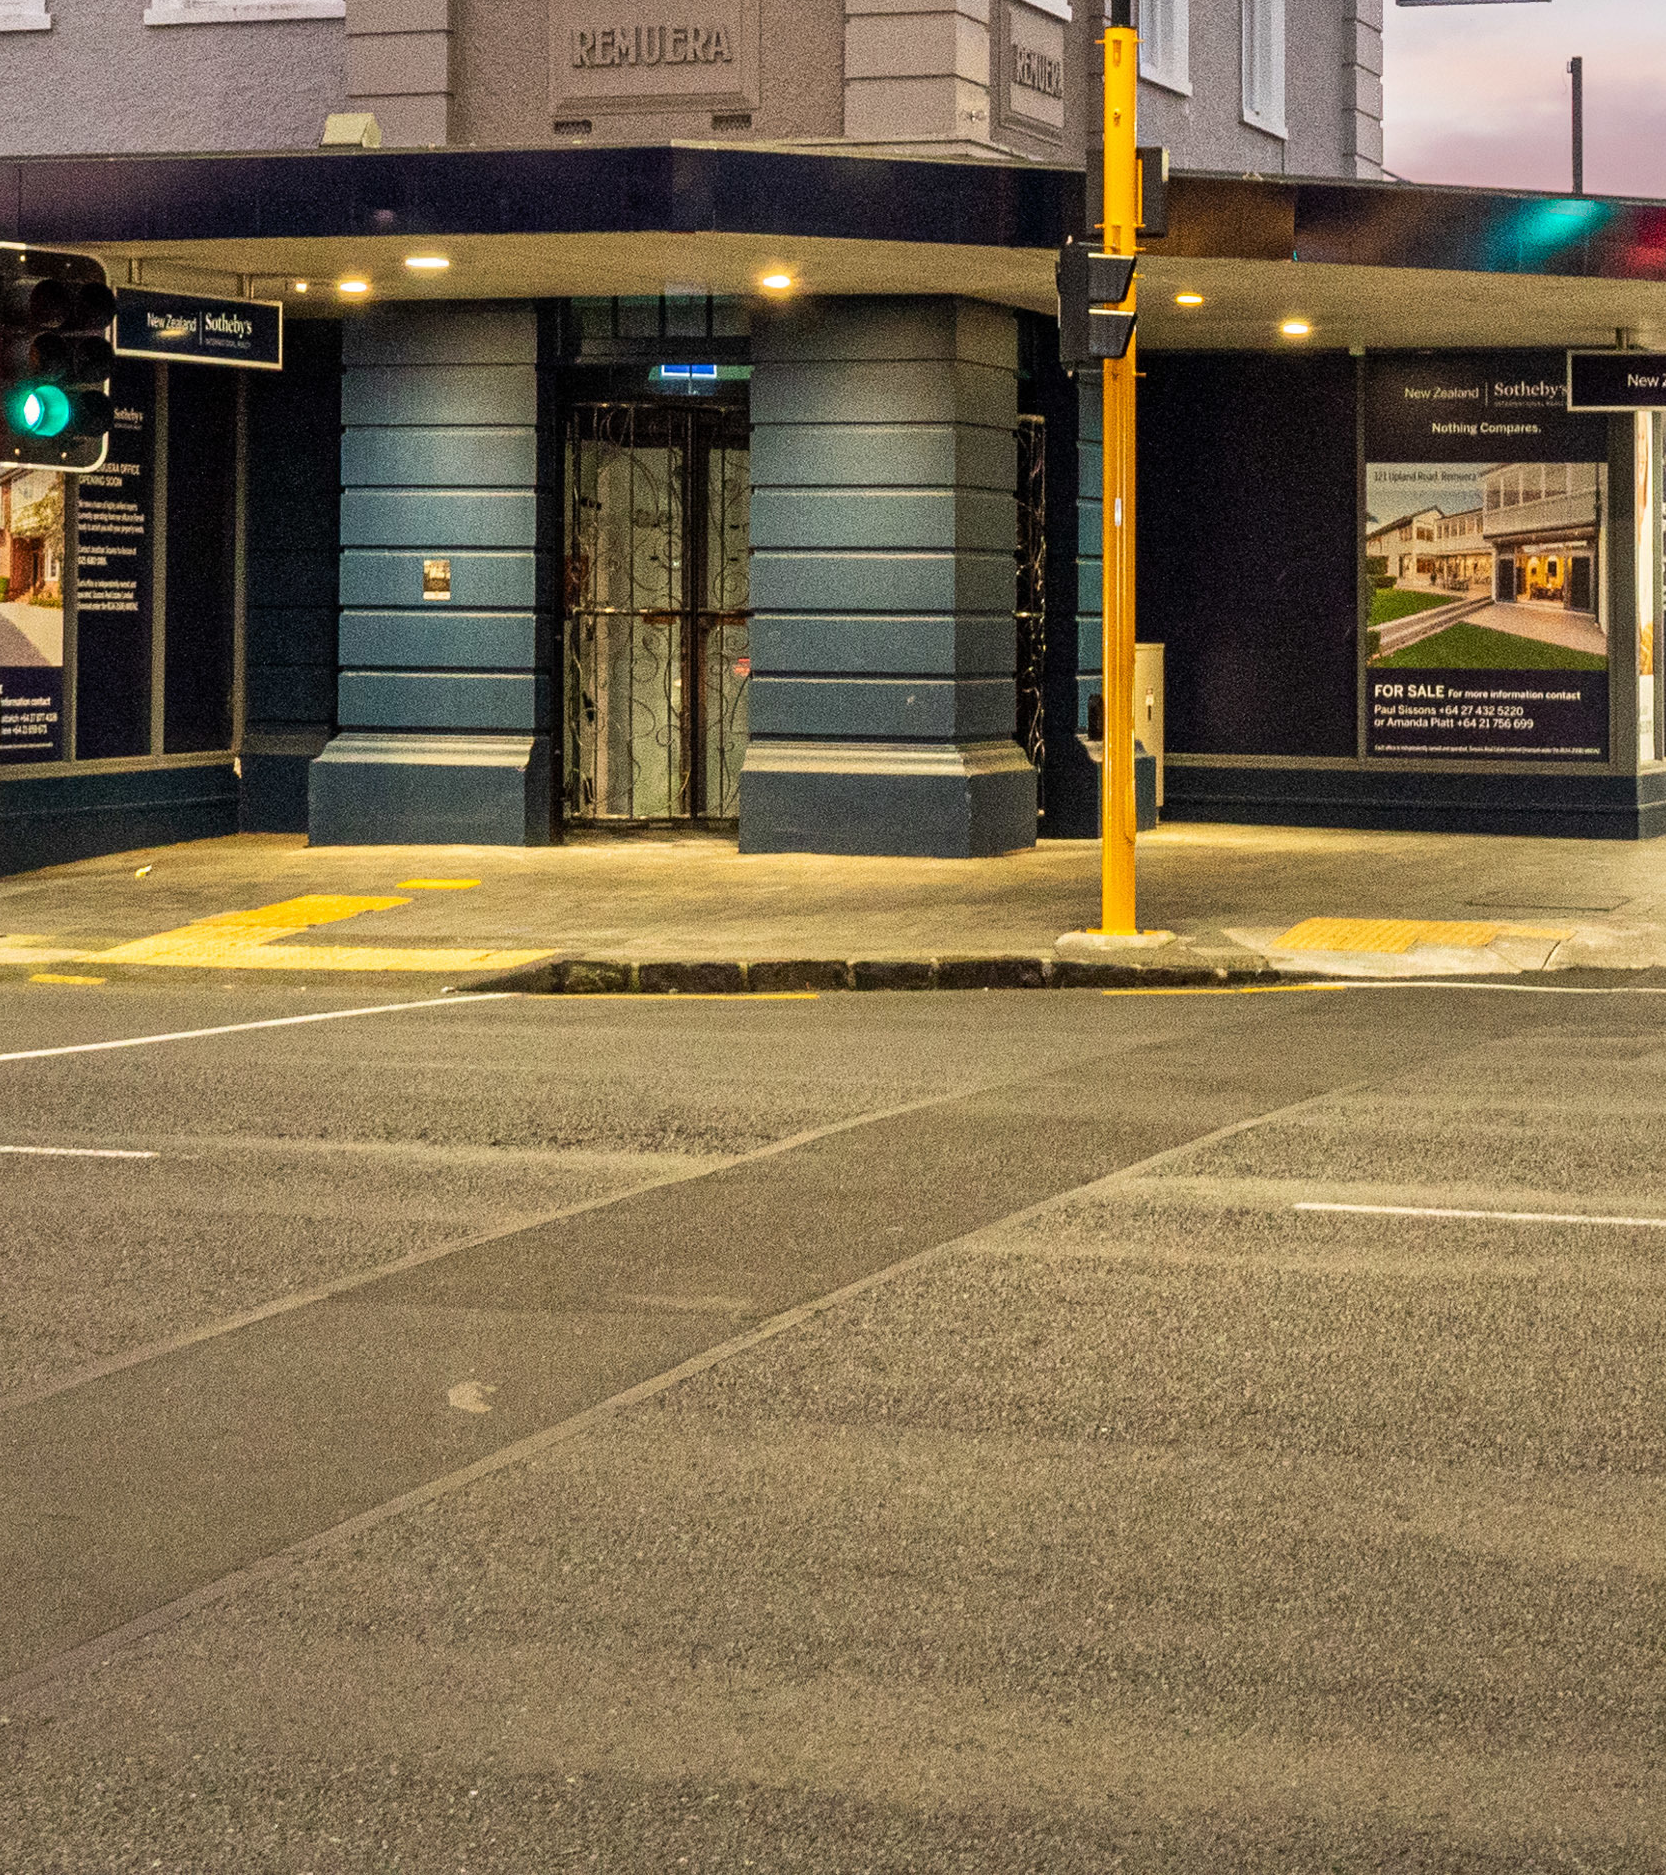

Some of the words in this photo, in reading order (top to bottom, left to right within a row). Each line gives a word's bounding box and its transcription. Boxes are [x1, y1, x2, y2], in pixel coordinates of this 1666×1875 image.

[570, 25, 732, 69] REMUERA
[147, 311, 165, 328] New
[165, 313, 197, 332] Zealand
[204, 311, 253, 339] Sotheby's
[1627, 374, 1658, 388] New
[1404, 387, 1431, 399] New
[1433, 386, 1480, 400] Zealand
[1432, 422, 1478, 436] Nothing
[1479, 423, 1542, 436] Compares.
[1374, 684, 1404, 698] FOR
[1407, 684, 1444, 699] SALE
[1448, 689, 1463, 699] For
[1464, 690, 1489, 699] more
[1490, 689, 1544, 701] information
[1545, 691, 1581, 702] contact
[1374, 704, 1396, 715] Paul
[1398, 704, 1436, 715] Sissons
[1438, 705, 1459, 715] +64
[1460, 705, 1473, 715] 27
[1474, 705, 1495, 716] 432
[1497, 706, 1524, 717] 5220
[1374, 719, 1385, 728] or
[1386, 717, 1428, 728] Amanda
[1430, 717, 1454, 729] Platt
[1456, 718, 1476, 729] +64
[1478, 718, 1490, 729] 21
[1492, 718, 1512, 729] 756
[1513, 719, 1534, 730] 699
